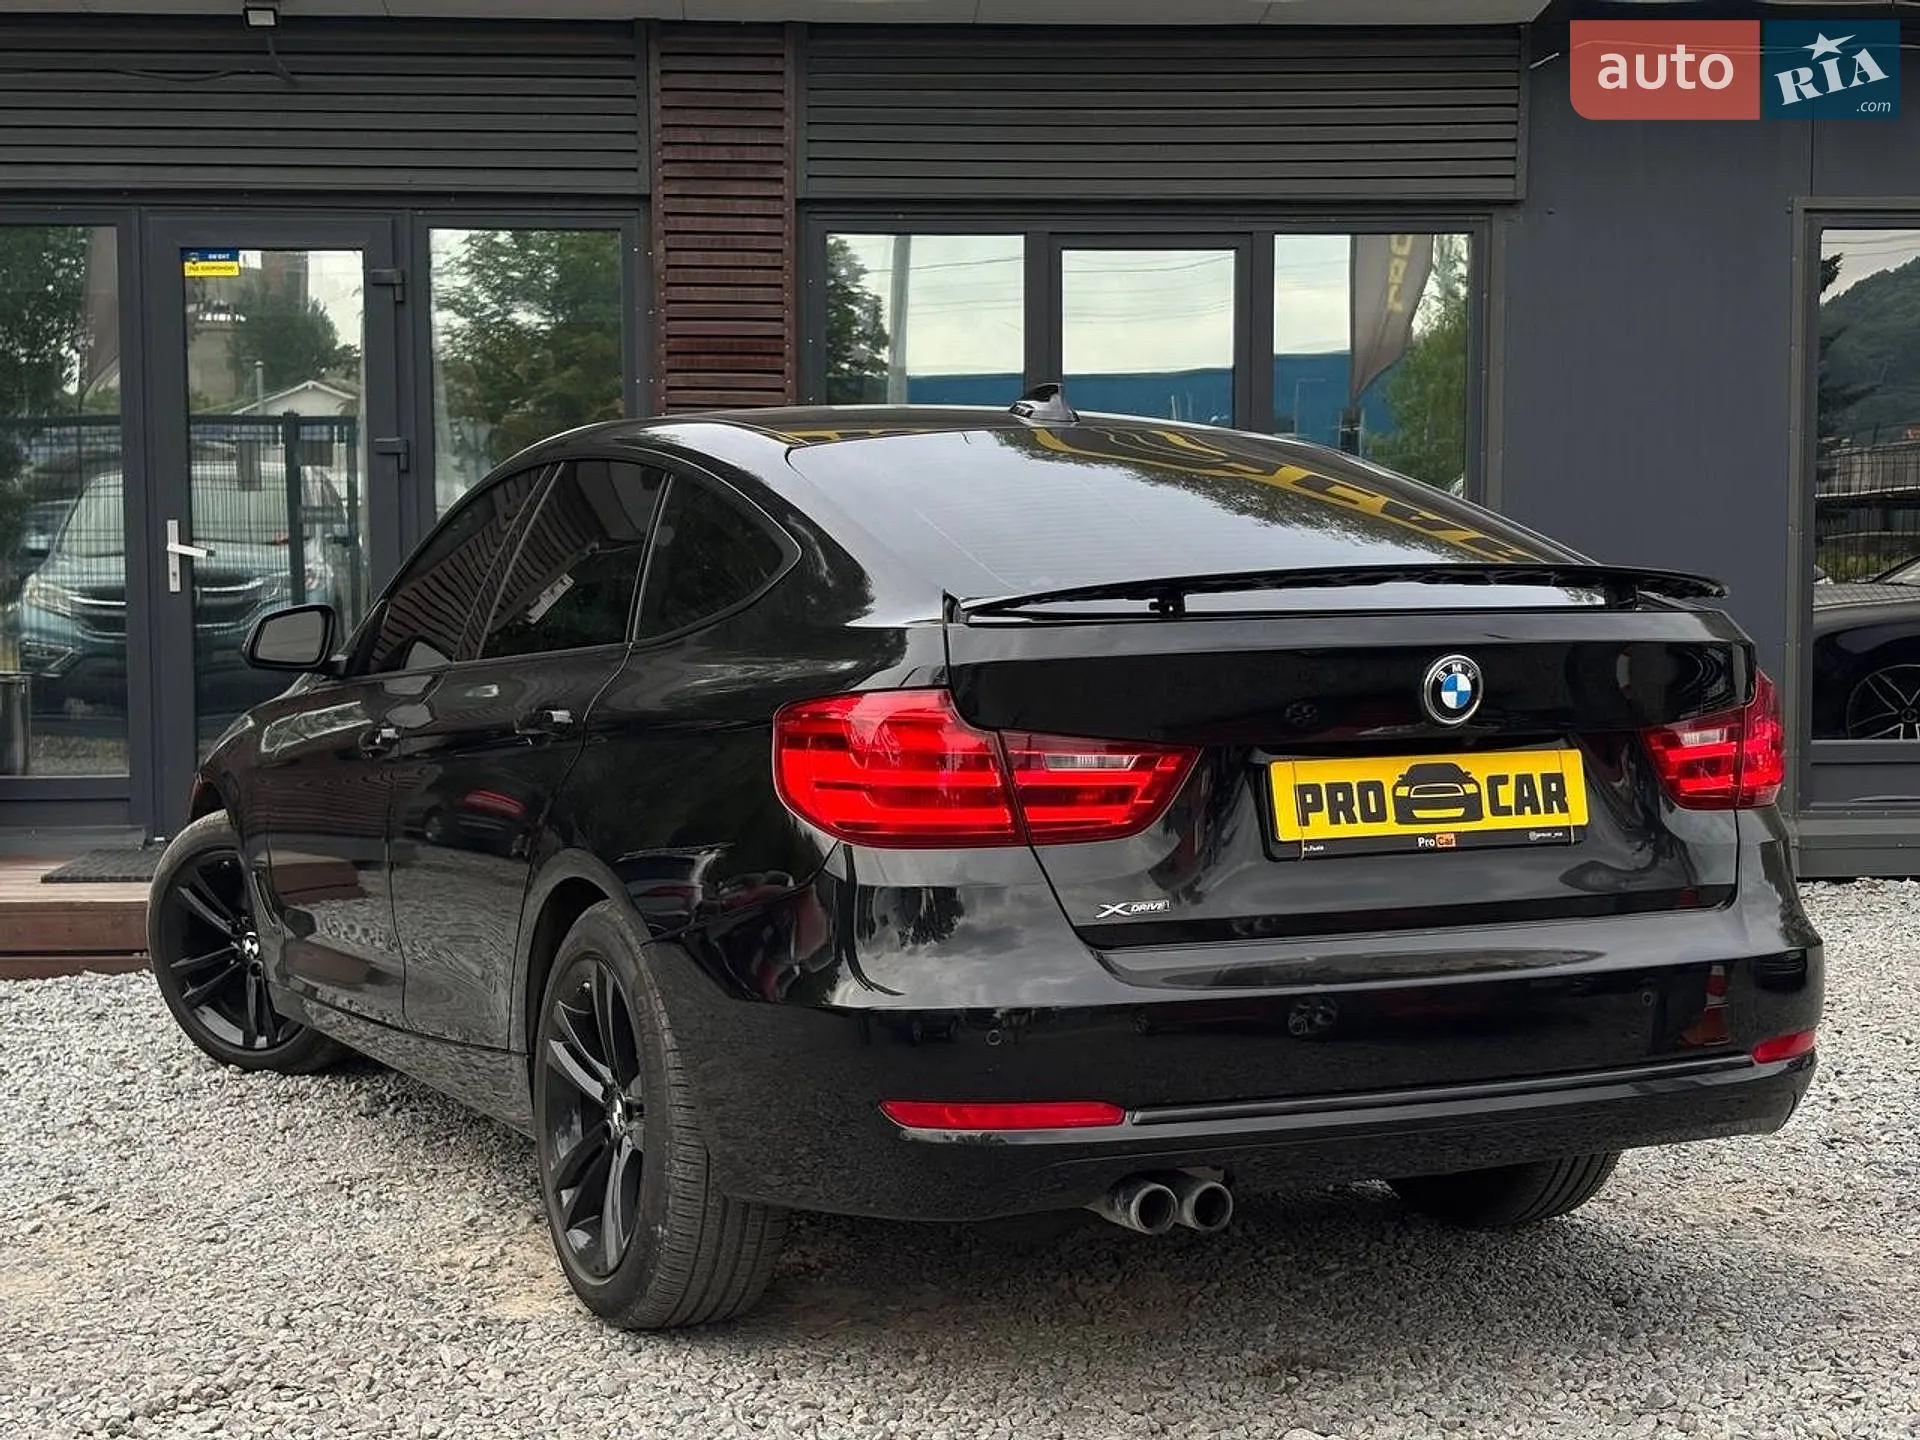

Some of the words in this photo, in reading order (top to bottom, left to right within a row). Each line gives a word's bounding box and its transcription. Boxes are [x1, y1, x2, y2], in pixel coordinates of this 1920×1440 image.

[1436, 663, 1478, 682] BMW
[1295, 780, 1388, 827] PRO
[1486, 772, 1569, 818] CAR
[1417, 836, 1436, 848] Pro
